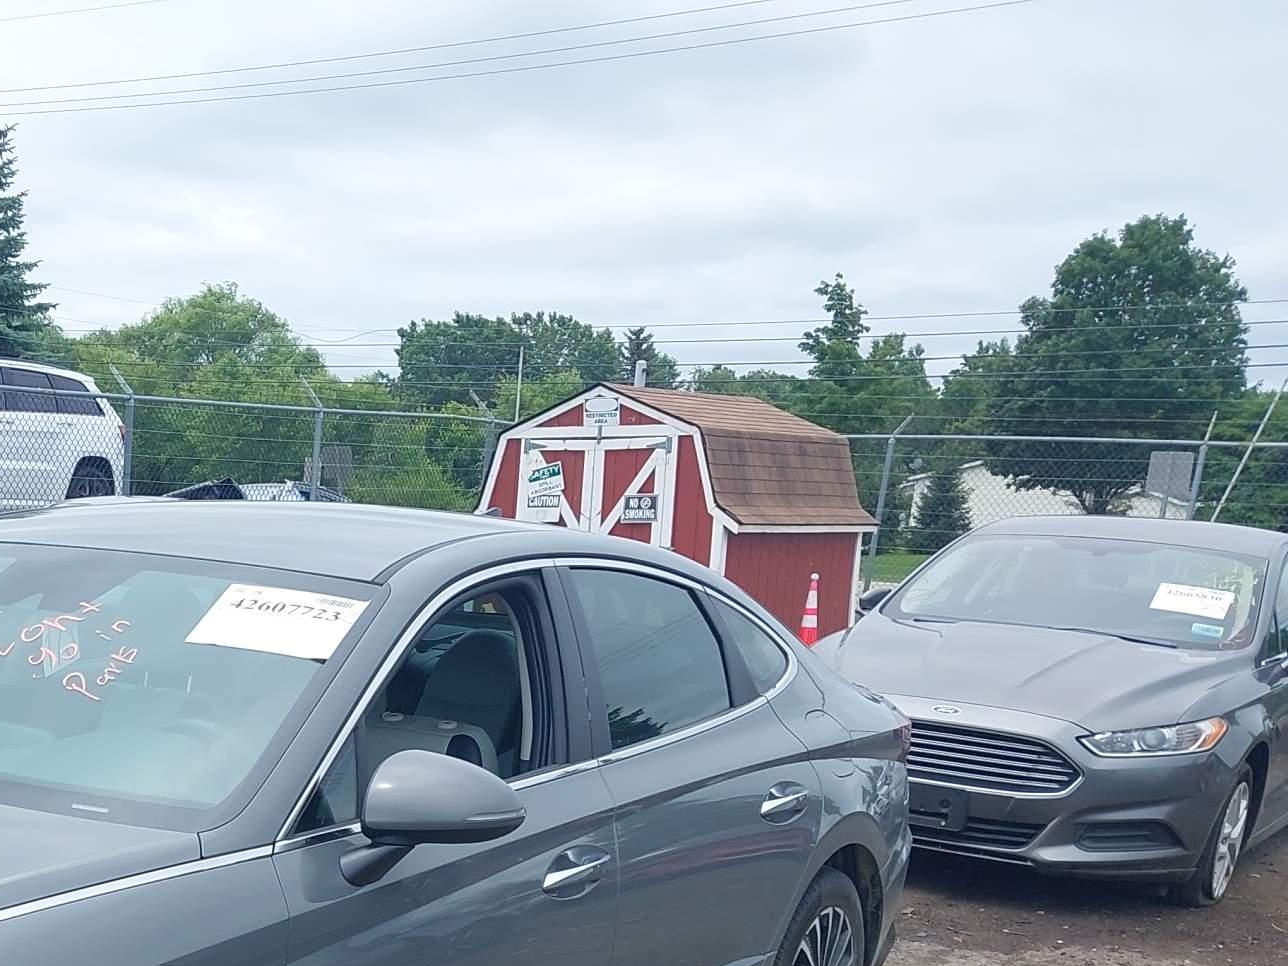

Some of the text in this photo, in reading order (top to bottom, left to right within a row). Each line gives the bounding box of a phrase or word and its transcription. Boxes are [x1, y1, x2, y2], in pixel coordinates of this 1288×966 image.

[527, 465, 560, 481] SAFETY
[528, 495, 560, 507] CAUTION
[629, 498, 639, 507] NO
[624, 508, 655, 519] SMOKING
[229, 597, 342, 622] 42607723
